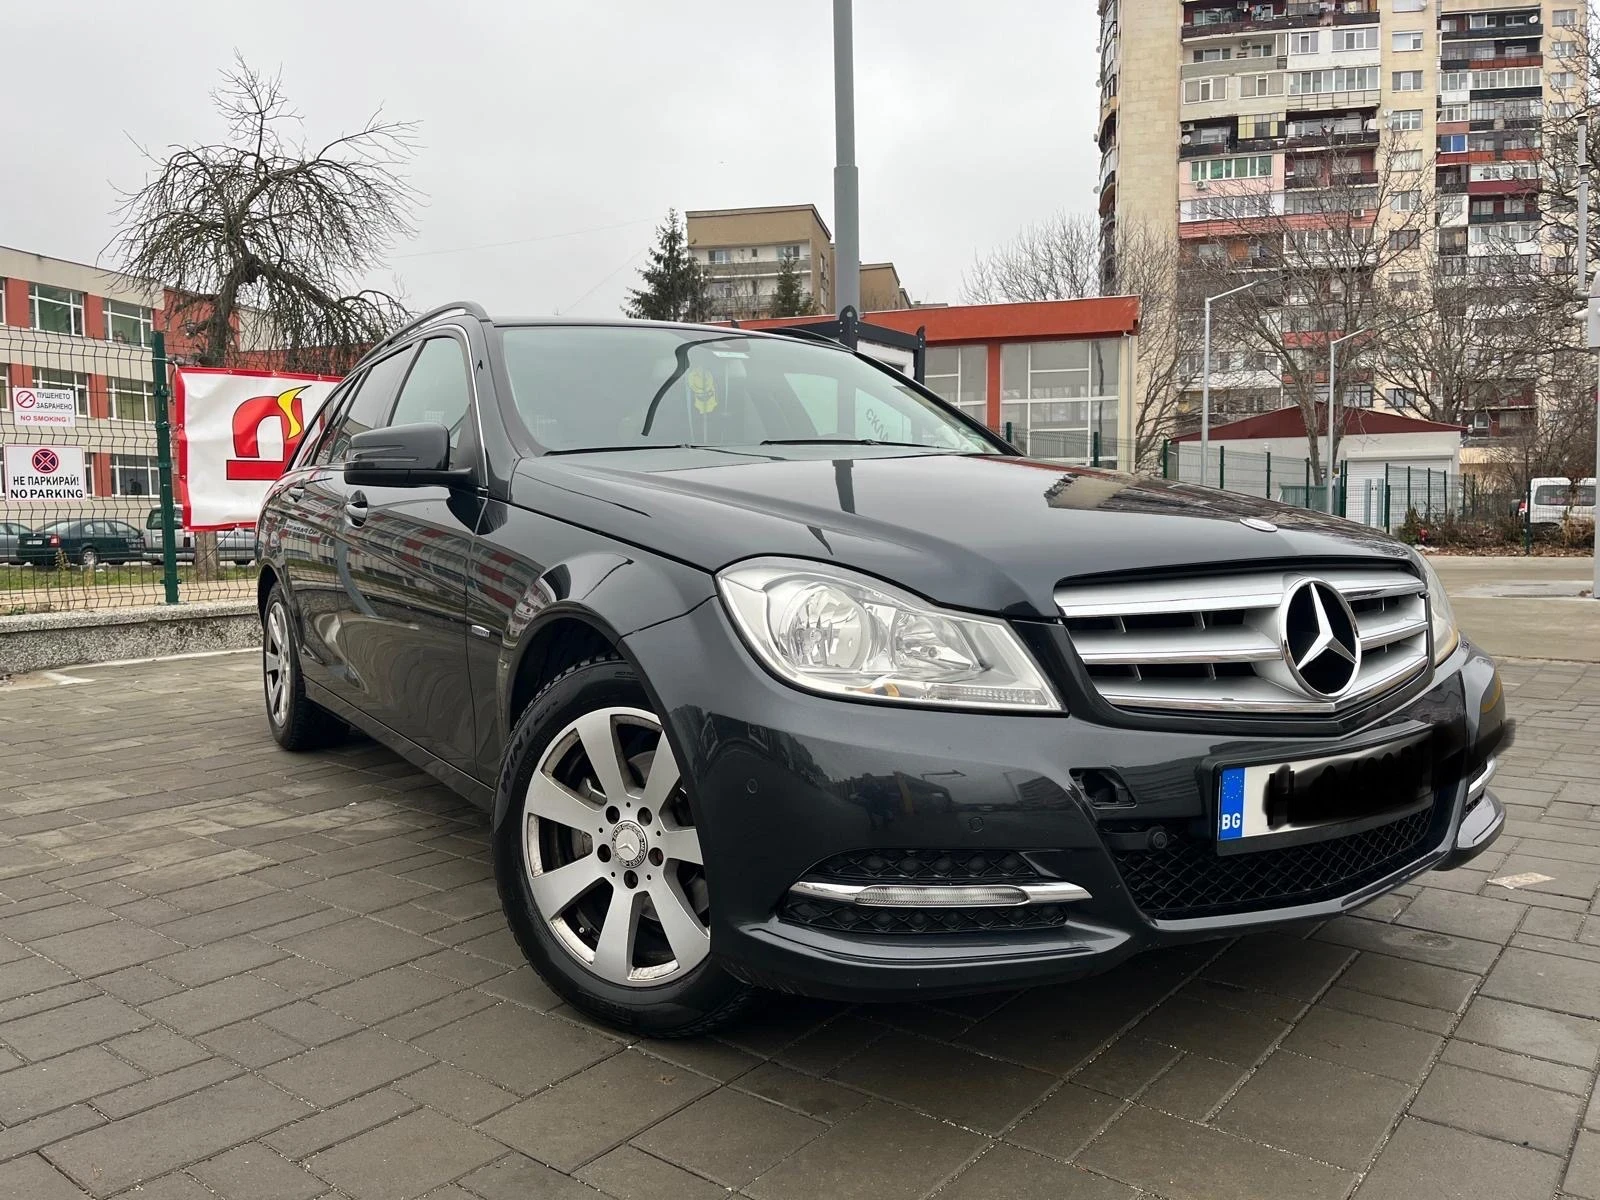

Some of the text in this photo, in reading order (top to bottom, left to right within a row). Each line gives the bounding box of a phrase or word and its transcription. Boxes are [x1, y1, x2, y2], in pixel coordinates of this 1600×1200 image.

[36, 392, 71, 400] ПУШЕНЕТО
[36, 402, 73, 410] ЗАБРАНЕНО
[13, 474, 79, 486] НЕ ПАРКИРАЙ!
[11, 489, 83, 498] NO PARKING
[1221, 812, 1241, 830] BG
